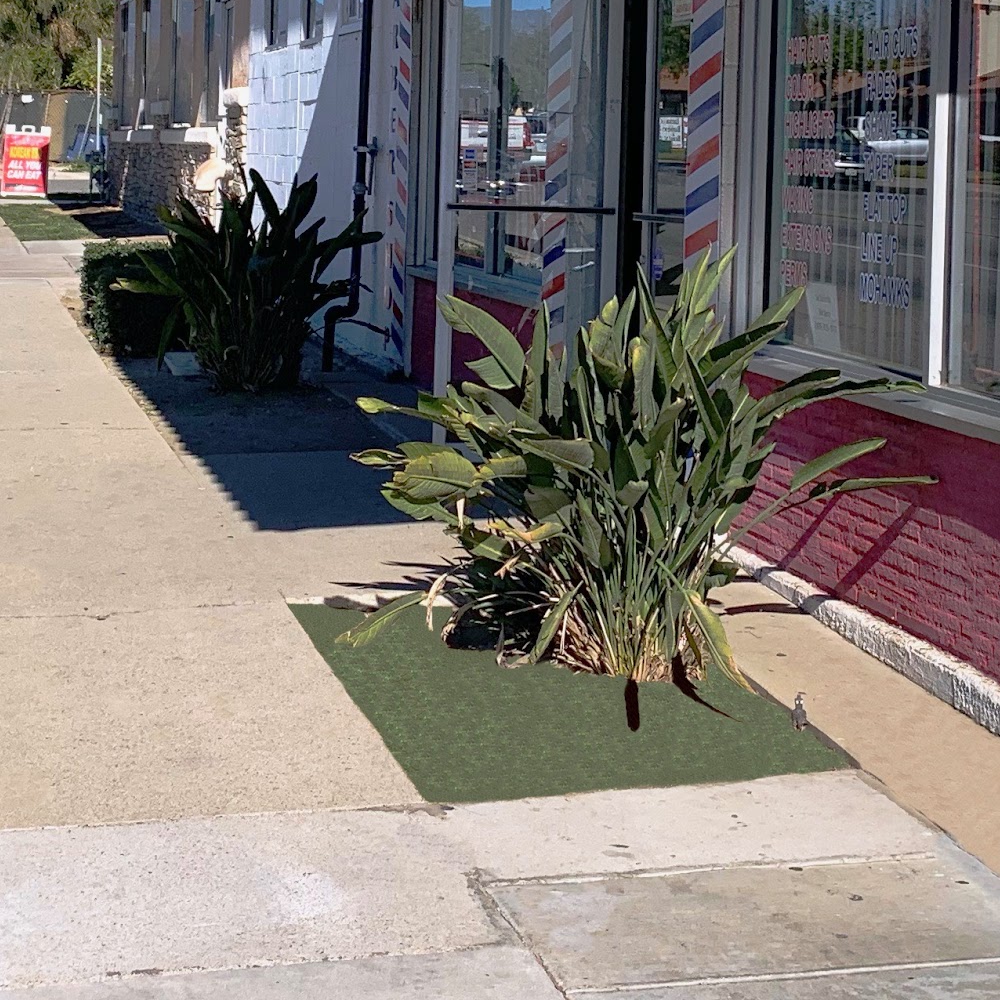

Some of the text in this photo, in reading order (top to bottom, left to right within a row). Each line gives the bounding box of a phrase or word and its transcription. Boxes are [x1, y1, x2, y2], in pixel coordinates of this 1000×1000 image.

[785, 73, 815, 101] COLOR
[866, 70, 897, 101] FADES
[784, 110, 836, 140] HIGHLIGHTS
[864, 110, 898, 141] SHAVE
[7, 170, 42, 180] CAN EAT
[8, 160, 42, 170] ALL YOU
[863, 151, 895, 182] TAPER
[781, 186, 814, 214] WAXING
[780, 222, 834, 256] EXTENSIONS
[861, 232, 898, 266] LINE UP
[780, 259, 808, 287] PERMS
[860, 271, 911, 310] MOHAWKS
